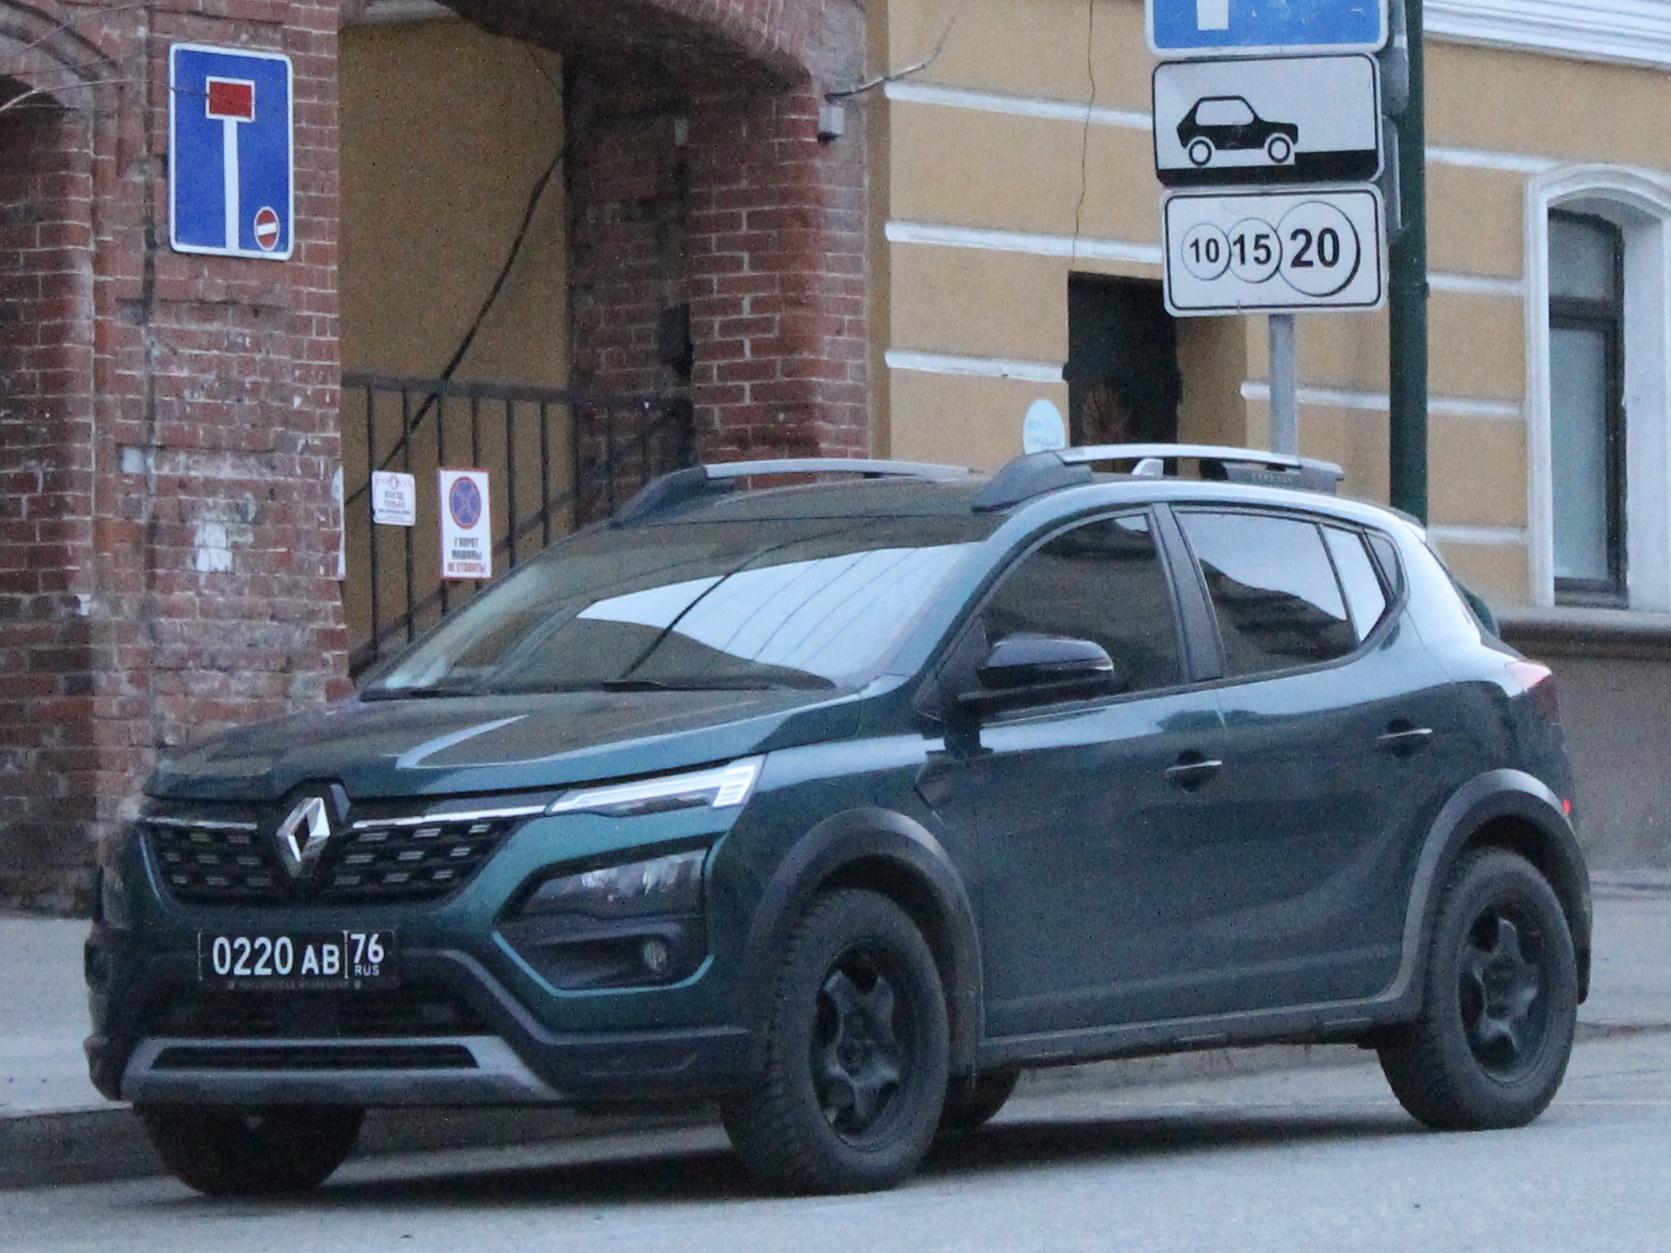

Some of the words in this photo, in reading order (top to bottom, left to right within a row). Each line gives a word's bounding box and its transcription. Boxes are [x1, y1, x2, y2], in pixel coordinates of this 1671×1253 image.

[1189, 238, 1220, 263] 10
[1232, 233, 1272, 265] 15
[1290, 227, 1340, 268] 20
[212, 936, 294, 976] 0220
[350, 933, 385, 964] 76
[354, 964, 380, 976] RUS
